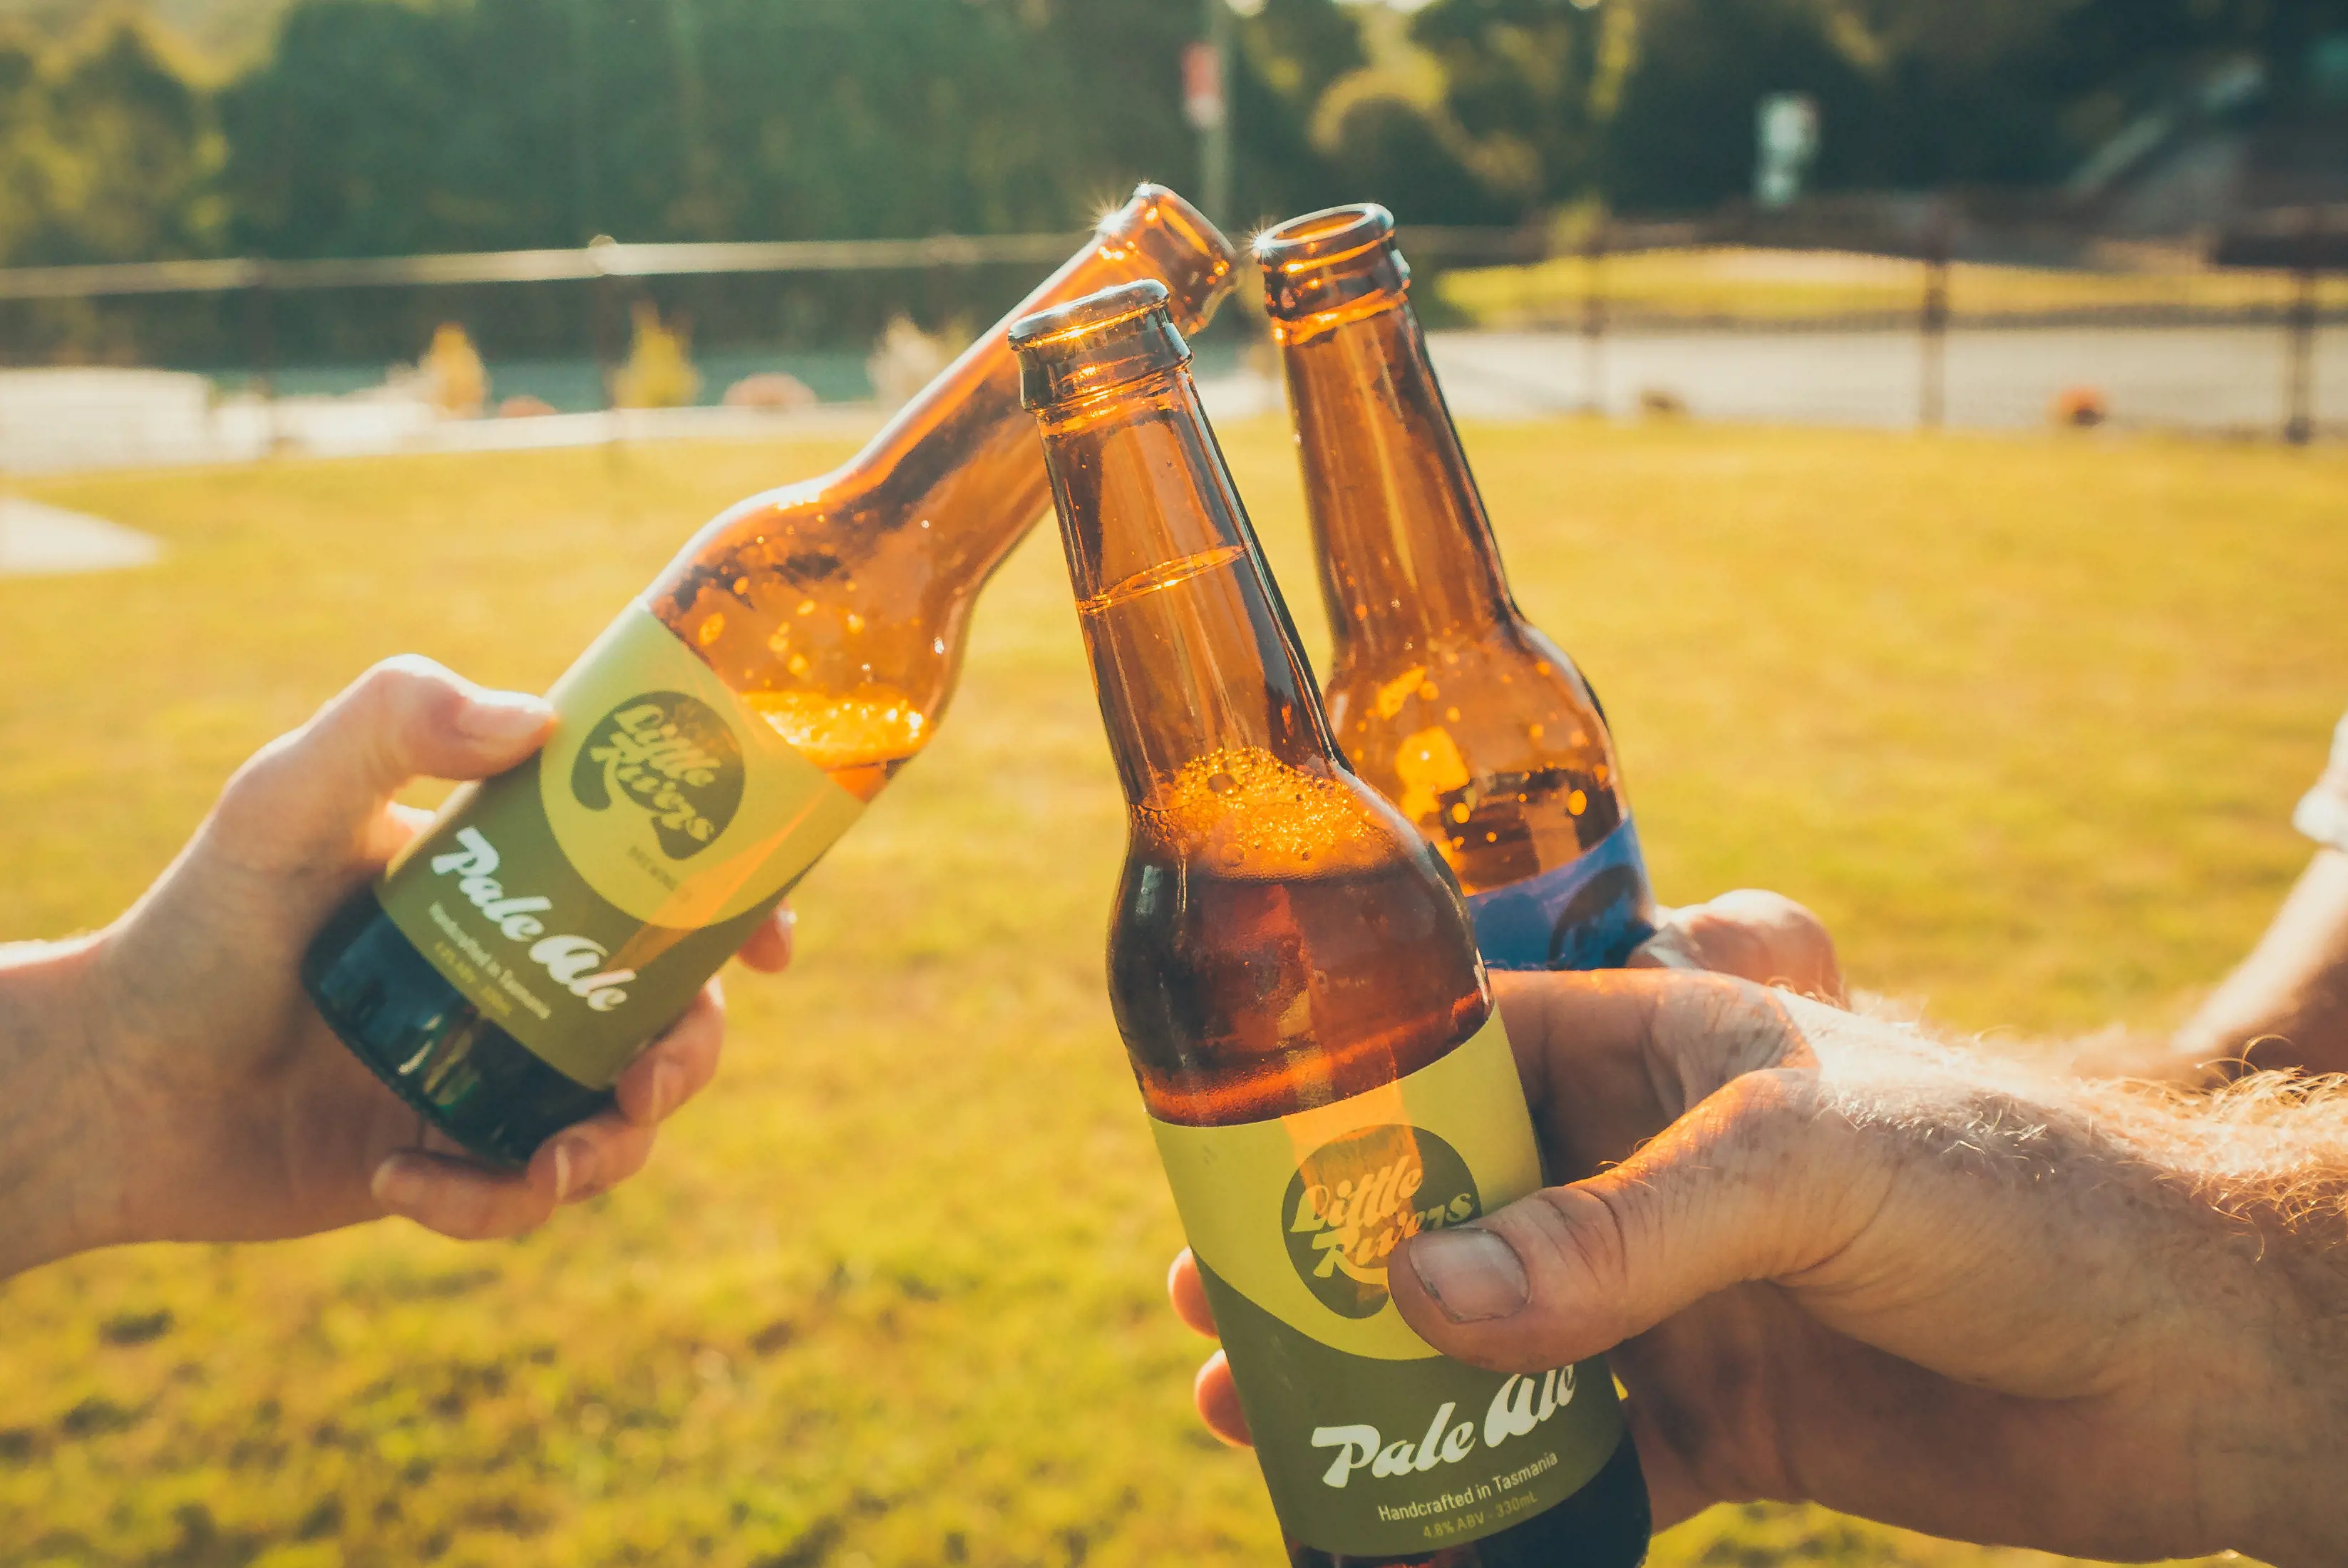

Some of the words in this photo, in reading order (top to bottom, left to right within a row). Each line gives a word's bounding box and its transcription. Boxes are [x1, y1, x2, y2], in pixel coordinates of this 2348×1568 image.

[614, 704, 722, 788] Little
[431, 825, 552, 942] Pale
[529, 934, 636, 1011] Ale
[1289, 1155, 1423, 1233] Little
[1311, 1402, 1476, 1489] Pale
[1483, 1363, 1577, 1448] Ale
[1377, 1487, 1475, 1522] Handcrafted
[1476, 1483, 1493, 1500] in
[1492, 1451, 1559, 1493] Tasmania
[1423, 1520, 1456, 1539] 4.8%
[1457, 1511, 1485, 1532] ABV
[1495, 1490, 1538, 1519] 330mL
